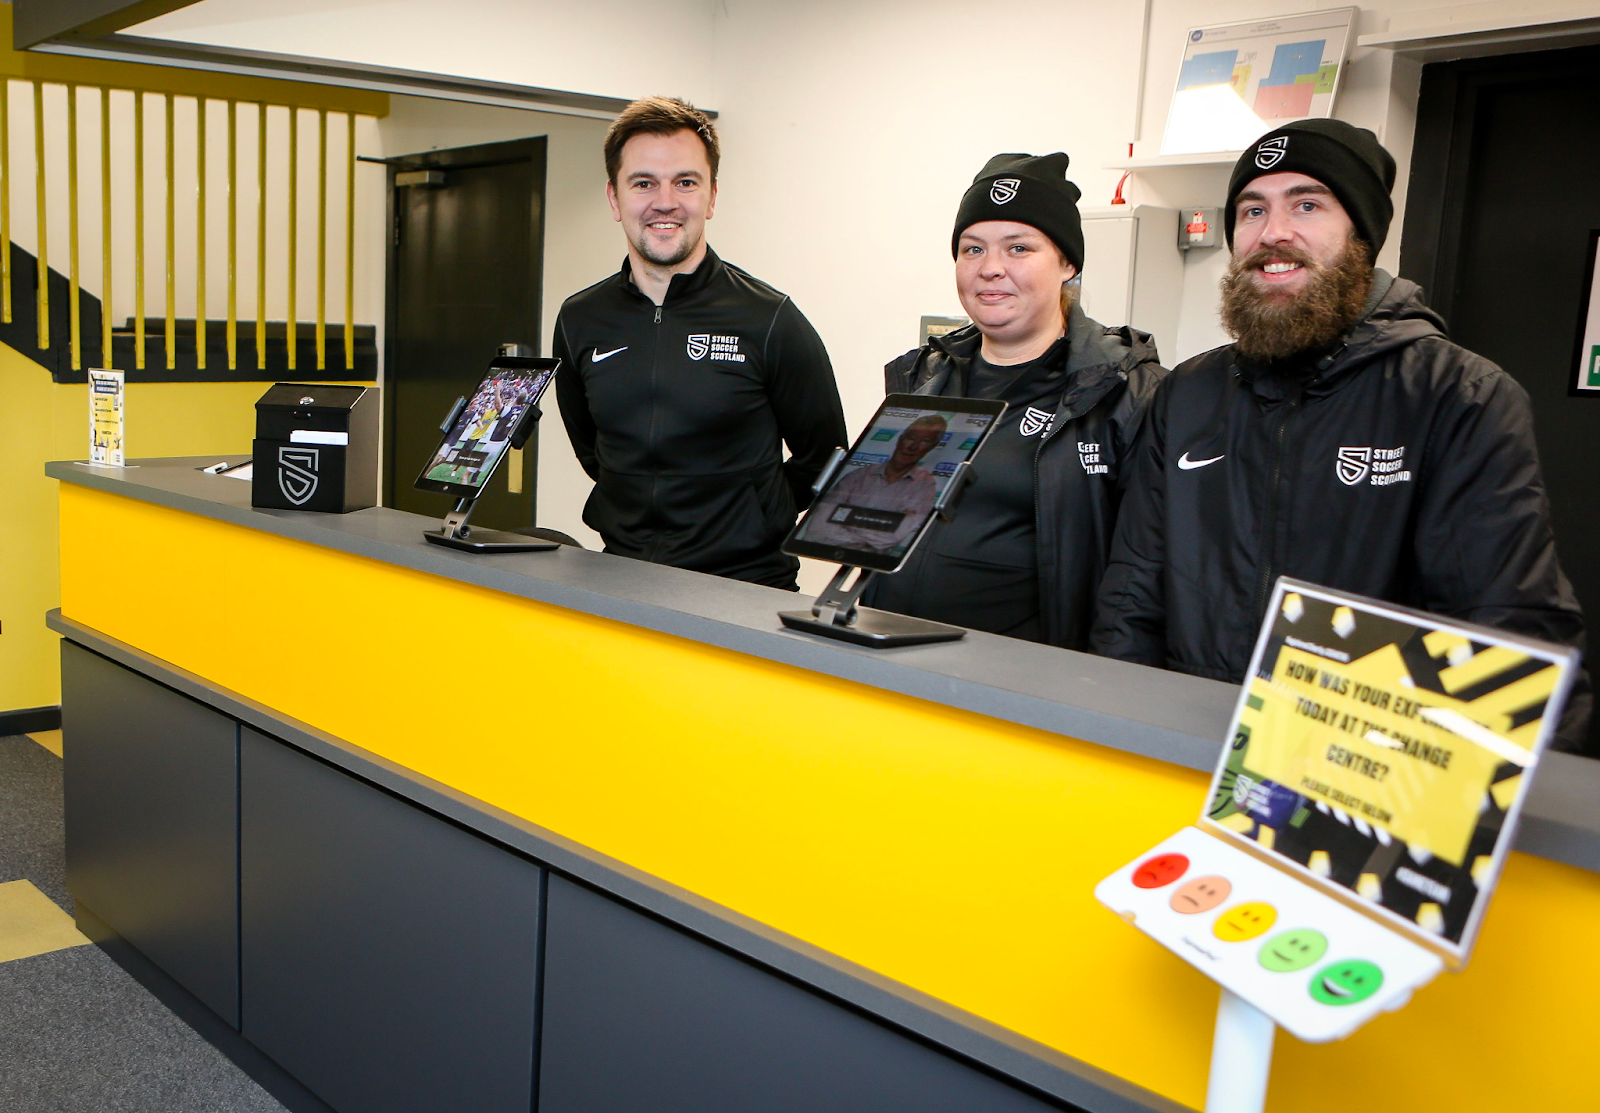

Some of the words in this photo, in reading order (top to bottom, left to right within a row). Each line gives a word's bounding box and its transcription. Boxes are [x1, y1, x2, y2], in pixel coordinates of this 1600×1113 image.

[712, 336, 739, 344] STREET
[711, 344, 738, 352] SOCCER
[710, 353, 745, 362] SCOTLAND
[1373, 446, 1405, 460] STREET
[1372, 459, 1403, 472] SOCCER
[1371, 471, 1411, 485] SCOTLAND
[1286, 661, 1316, 684] HOW
[1317, 671, 1349, 695] WAS
[1352, 683, 1390, 708] YOUR
[1295, 697, 1338, 725] TODAY
[1339, 714, 1359, 733] AT
[1326, 745, 1389, 782] CENTRE?
